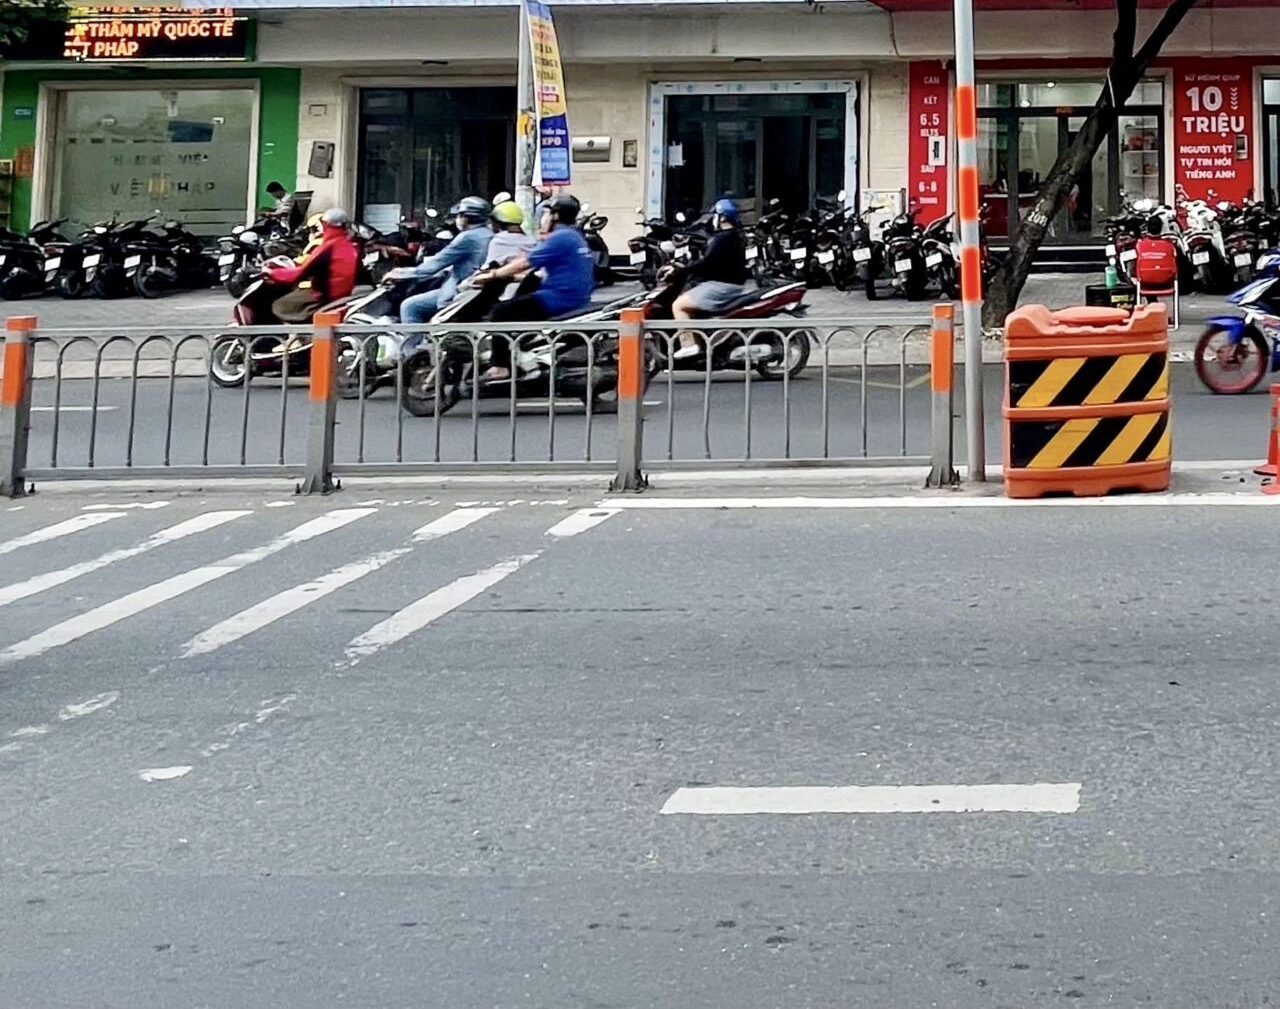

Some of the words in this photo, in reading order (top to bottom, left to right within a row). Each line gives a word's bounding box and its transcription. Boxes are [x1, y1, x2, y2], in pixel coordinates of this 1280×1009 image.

[94, 39, 139, 57] PHÁP
[1185, 86, 1223, 112] 10
[919, 113, 940, 126] 6.5
[1182, 112, 1245, 138] TRIỆU
[1212, 144, 1233, 155] VIỆT
[1197, 158, 1213, 166] TIN
[1185, 168, 1213, 179] TIẾNG
[1214, 171, 1236, 179] ANH
